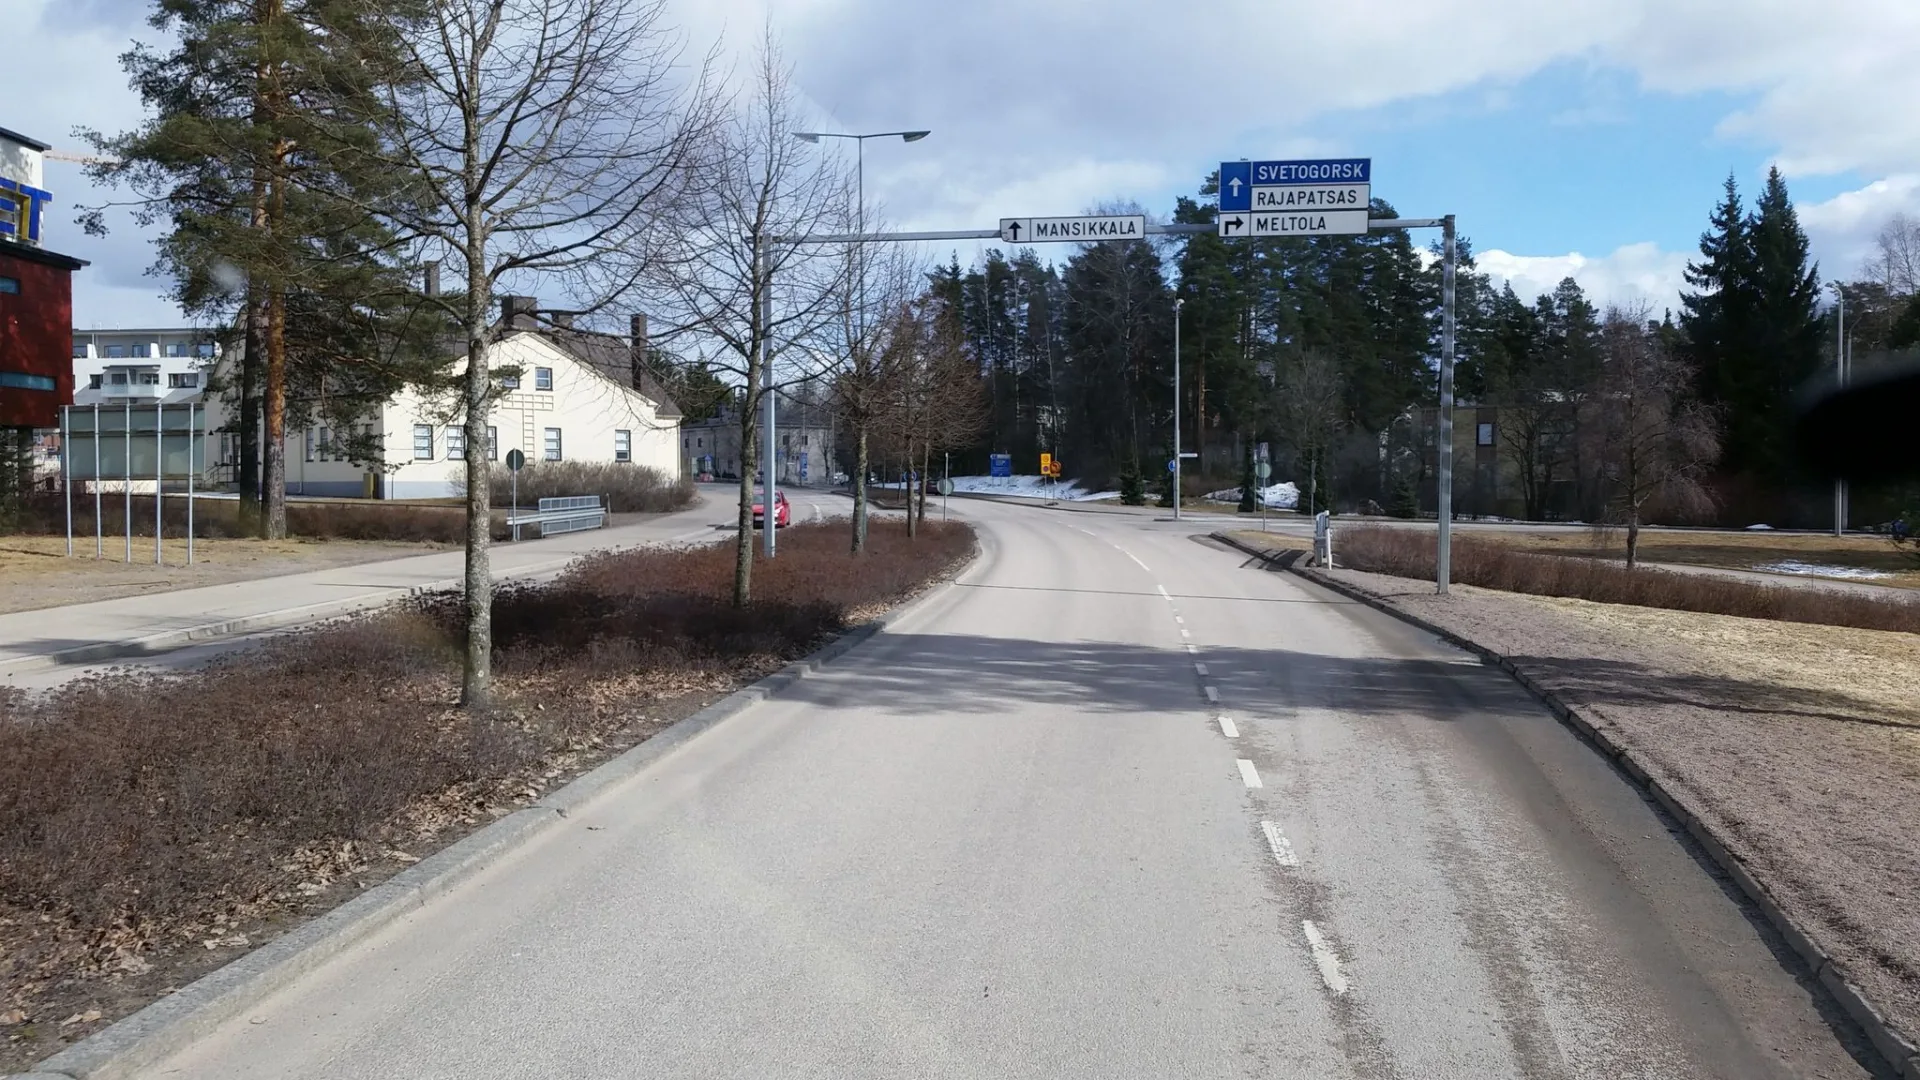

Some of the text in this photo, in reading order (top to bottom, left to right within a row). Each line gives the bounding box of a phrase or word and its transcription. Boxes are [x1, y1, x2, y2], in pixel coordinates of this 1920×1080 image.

[1258, 163, 1364, 180] SVETOGORSK
[1257, 189, 1357, 206] RAJAPATSAS
[1036, 221, 1136, 237] MANSIKKALA
[1256, 216, 1326, 231] MELTOLA
